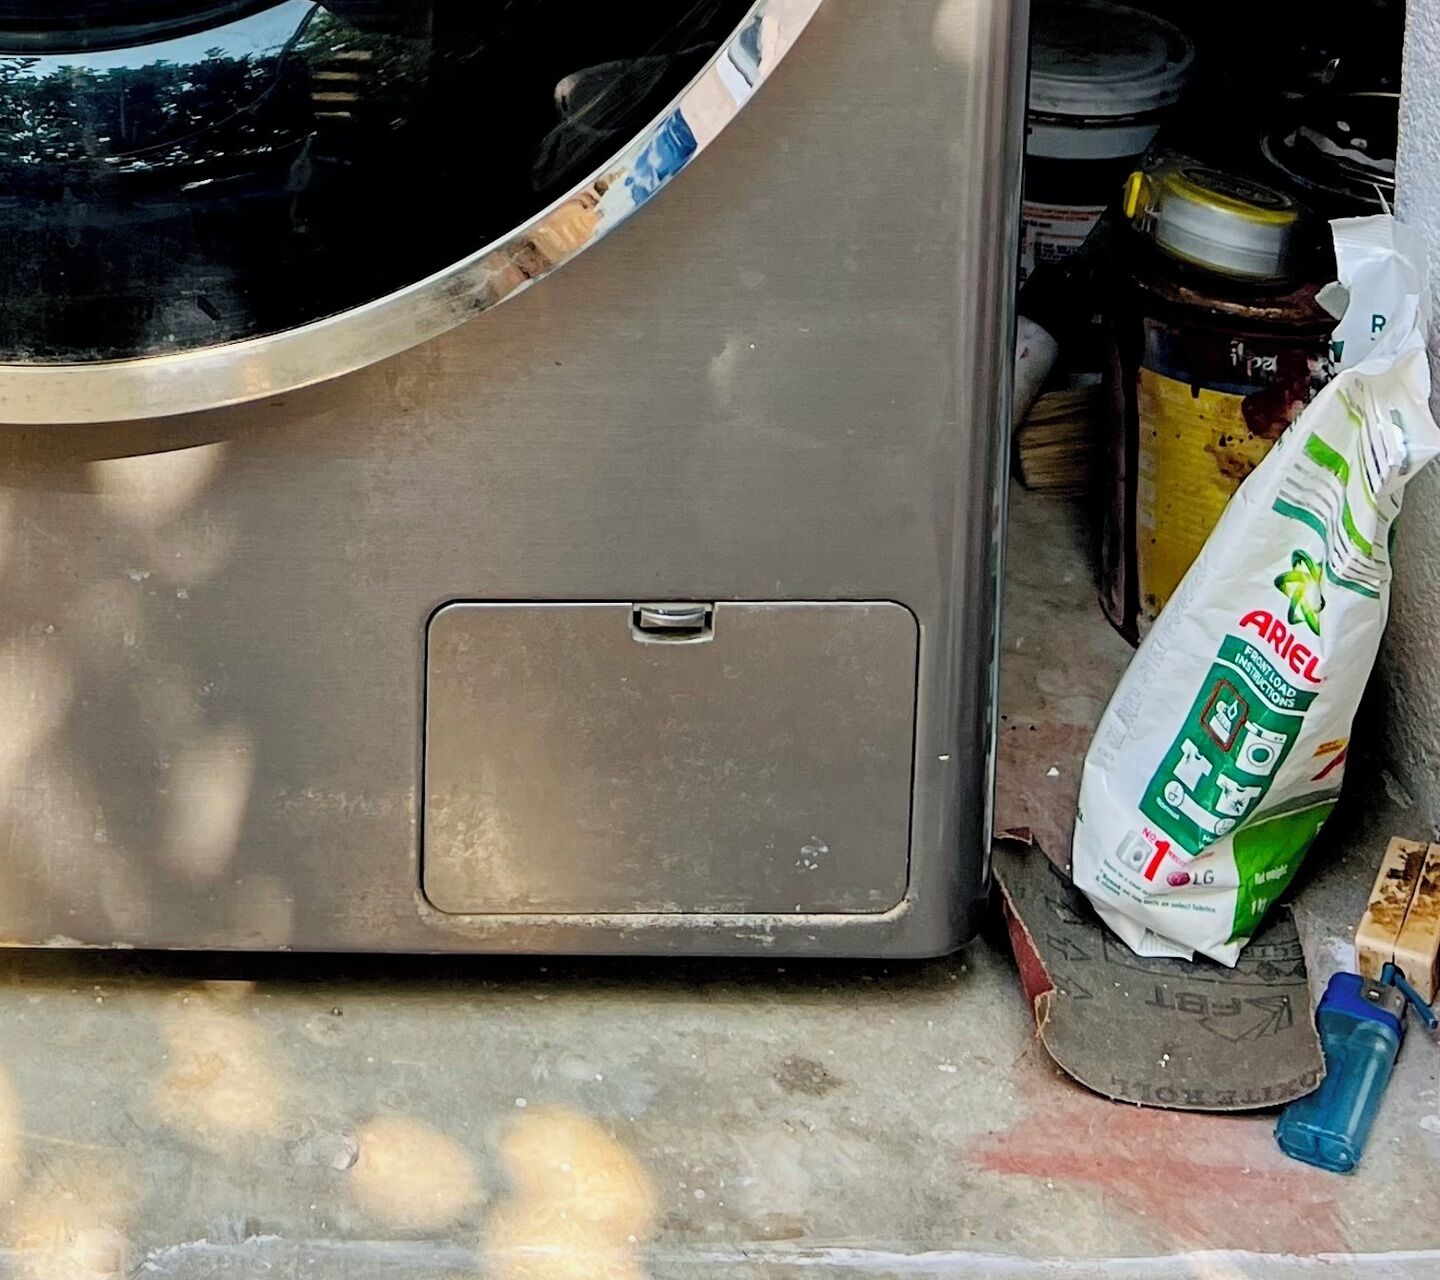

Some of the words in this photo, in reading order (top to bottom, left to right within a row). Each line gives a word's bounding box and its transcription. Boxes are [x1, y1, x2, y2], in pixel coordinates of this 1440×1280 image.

[1238, 610, 1322, 684] ARIEL
[1243, 644, 1273, 676] FRONT
[1268, 672, 1297, 698] LOAD
[1234, 652, 1296, 708] INSTRUCTIONS
[1143, 840, 1171, 882] 1
[1193, 869, 1216, 886] LG
